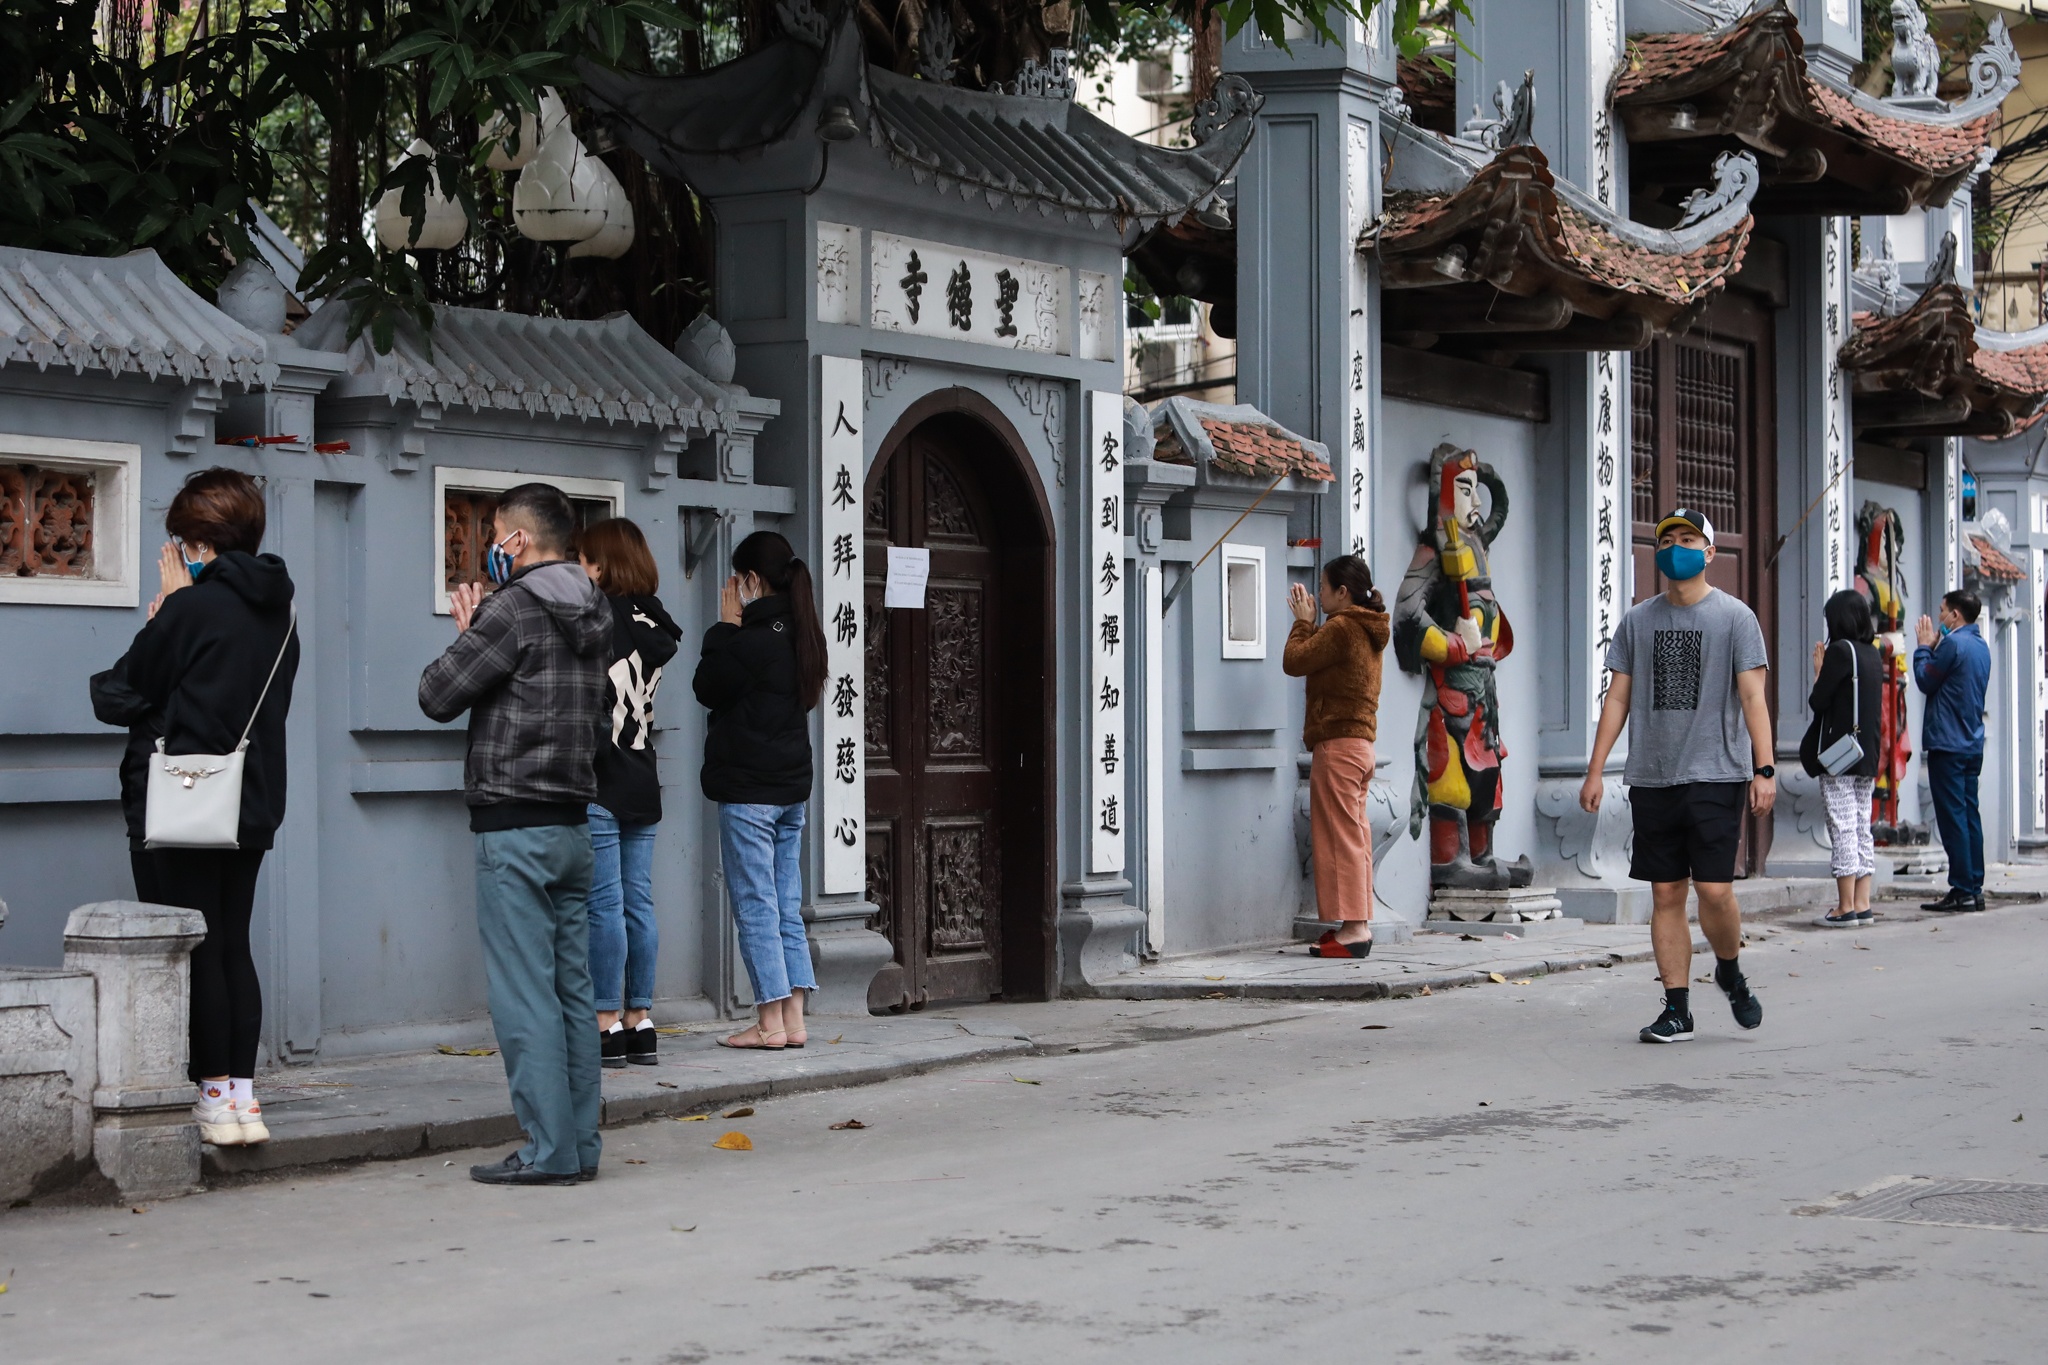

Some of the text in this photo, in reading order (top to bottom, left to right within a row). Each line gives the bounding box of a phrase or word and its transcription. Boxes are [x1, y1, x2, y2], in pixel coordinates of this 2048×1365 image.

[1826, 216, 1841, 595] 殿宇輝煌人傑地靈
[830, 400, 858, 847] 人來拜佛發慈心
[1098, 430, 1121, 836] 客到參禪知善道
[1654, 630, 1703, 641] MOTION
